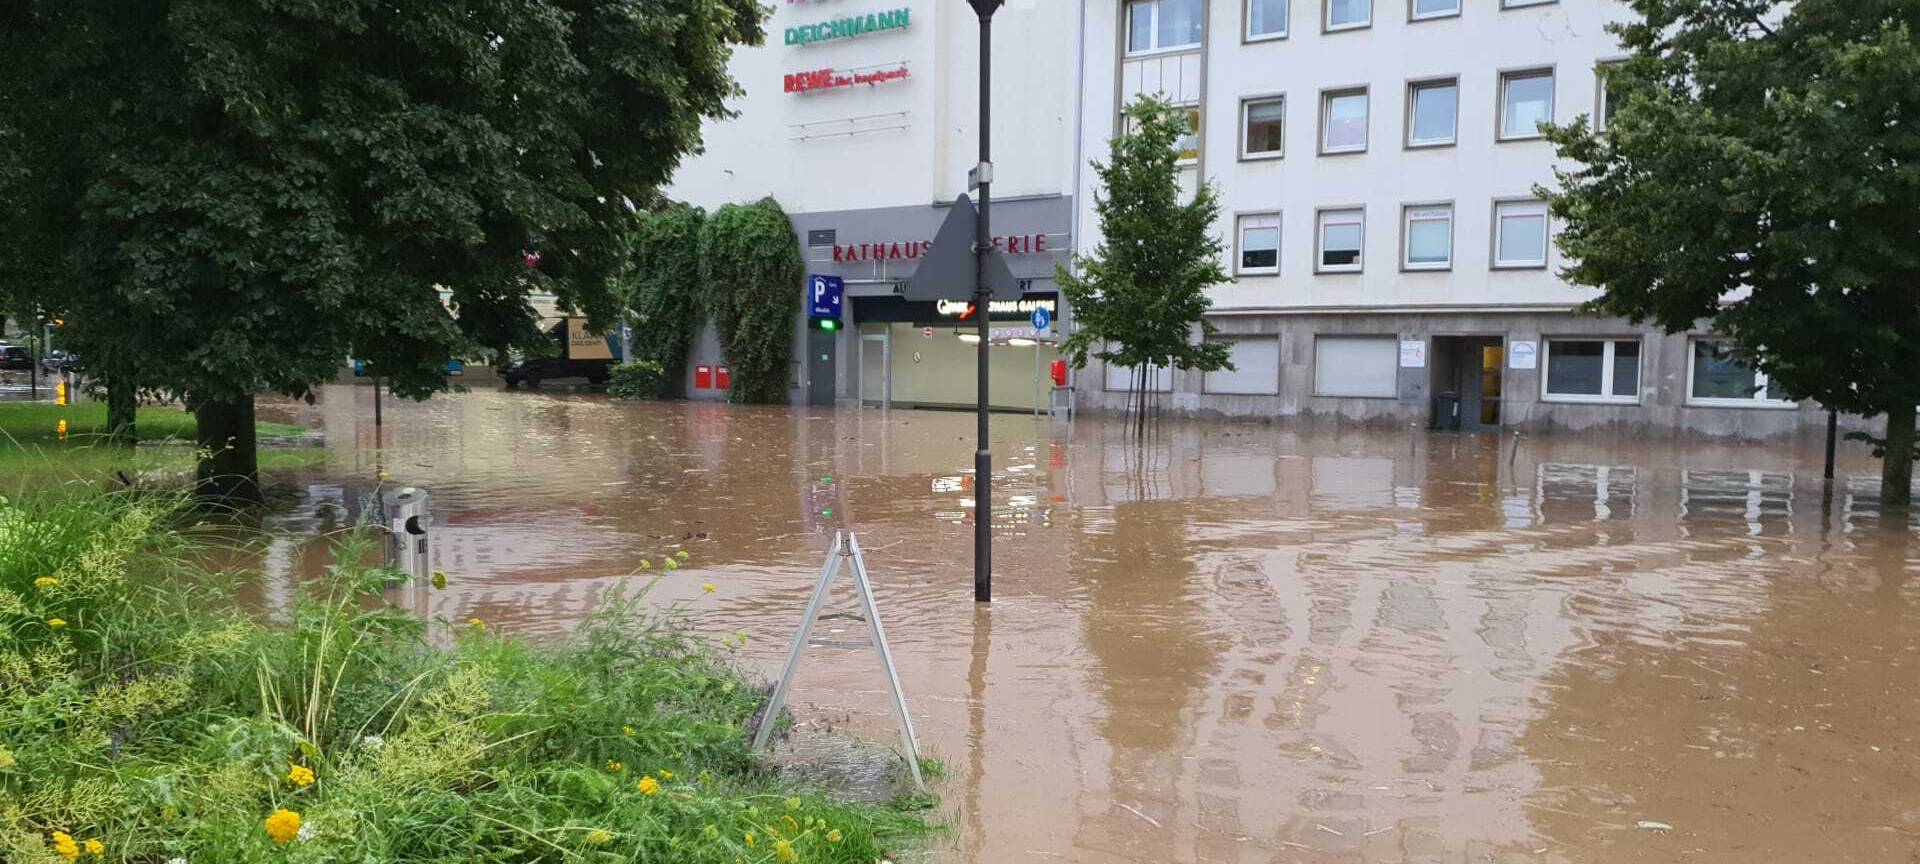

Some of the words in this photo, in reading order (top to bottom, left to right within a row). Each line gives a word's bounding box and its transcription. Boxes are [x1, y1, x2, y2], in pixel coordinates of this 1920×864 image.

[784, 7, 910, 46] DEICHMANN
[784, 68, 832, 93] REWE
[815, 281, 825, 303] P
